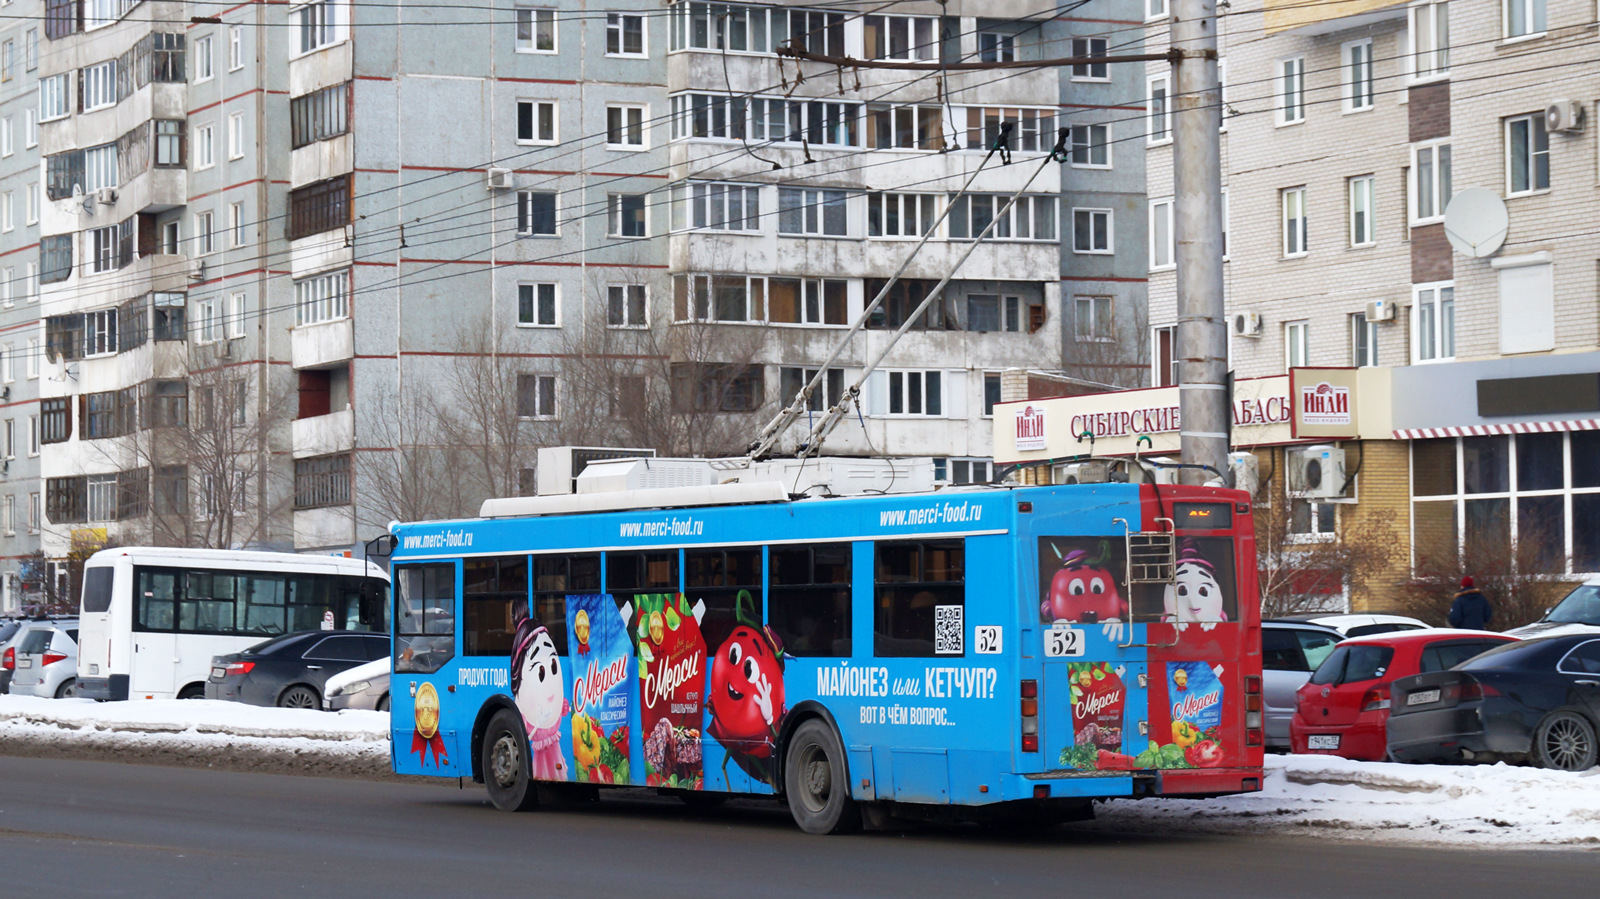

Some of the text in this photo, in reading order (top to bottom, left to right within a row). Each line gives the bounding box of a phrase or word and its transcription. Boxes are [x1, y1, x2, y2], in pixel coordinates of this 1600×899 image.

[1304, 392, 1348, 415] ИНДИ
[1070, 406, 1181, 439] СИБИРСКИЕ
[880, 501, 982, 526] www.merci-food.ru
[620, 517, 704, 538] www.merci-food.ru
[404, 530, 473, 549] www.merci-food.ru
[980, 629, 997, 652] 52
[1052, 632, 1077, 654] 52
[458, 668, 508, 686] ПРОДУКТ ГОДА
[574, 655, 628, 713] Мерси
[645, 652, 699, 709] Мерси
[817, 662, 998, 699] МАЙОНЕЗ или КЕТЧУП?
[860, 706, 956, 726] ВОТ В ЧЁМ ВОПРОС...
